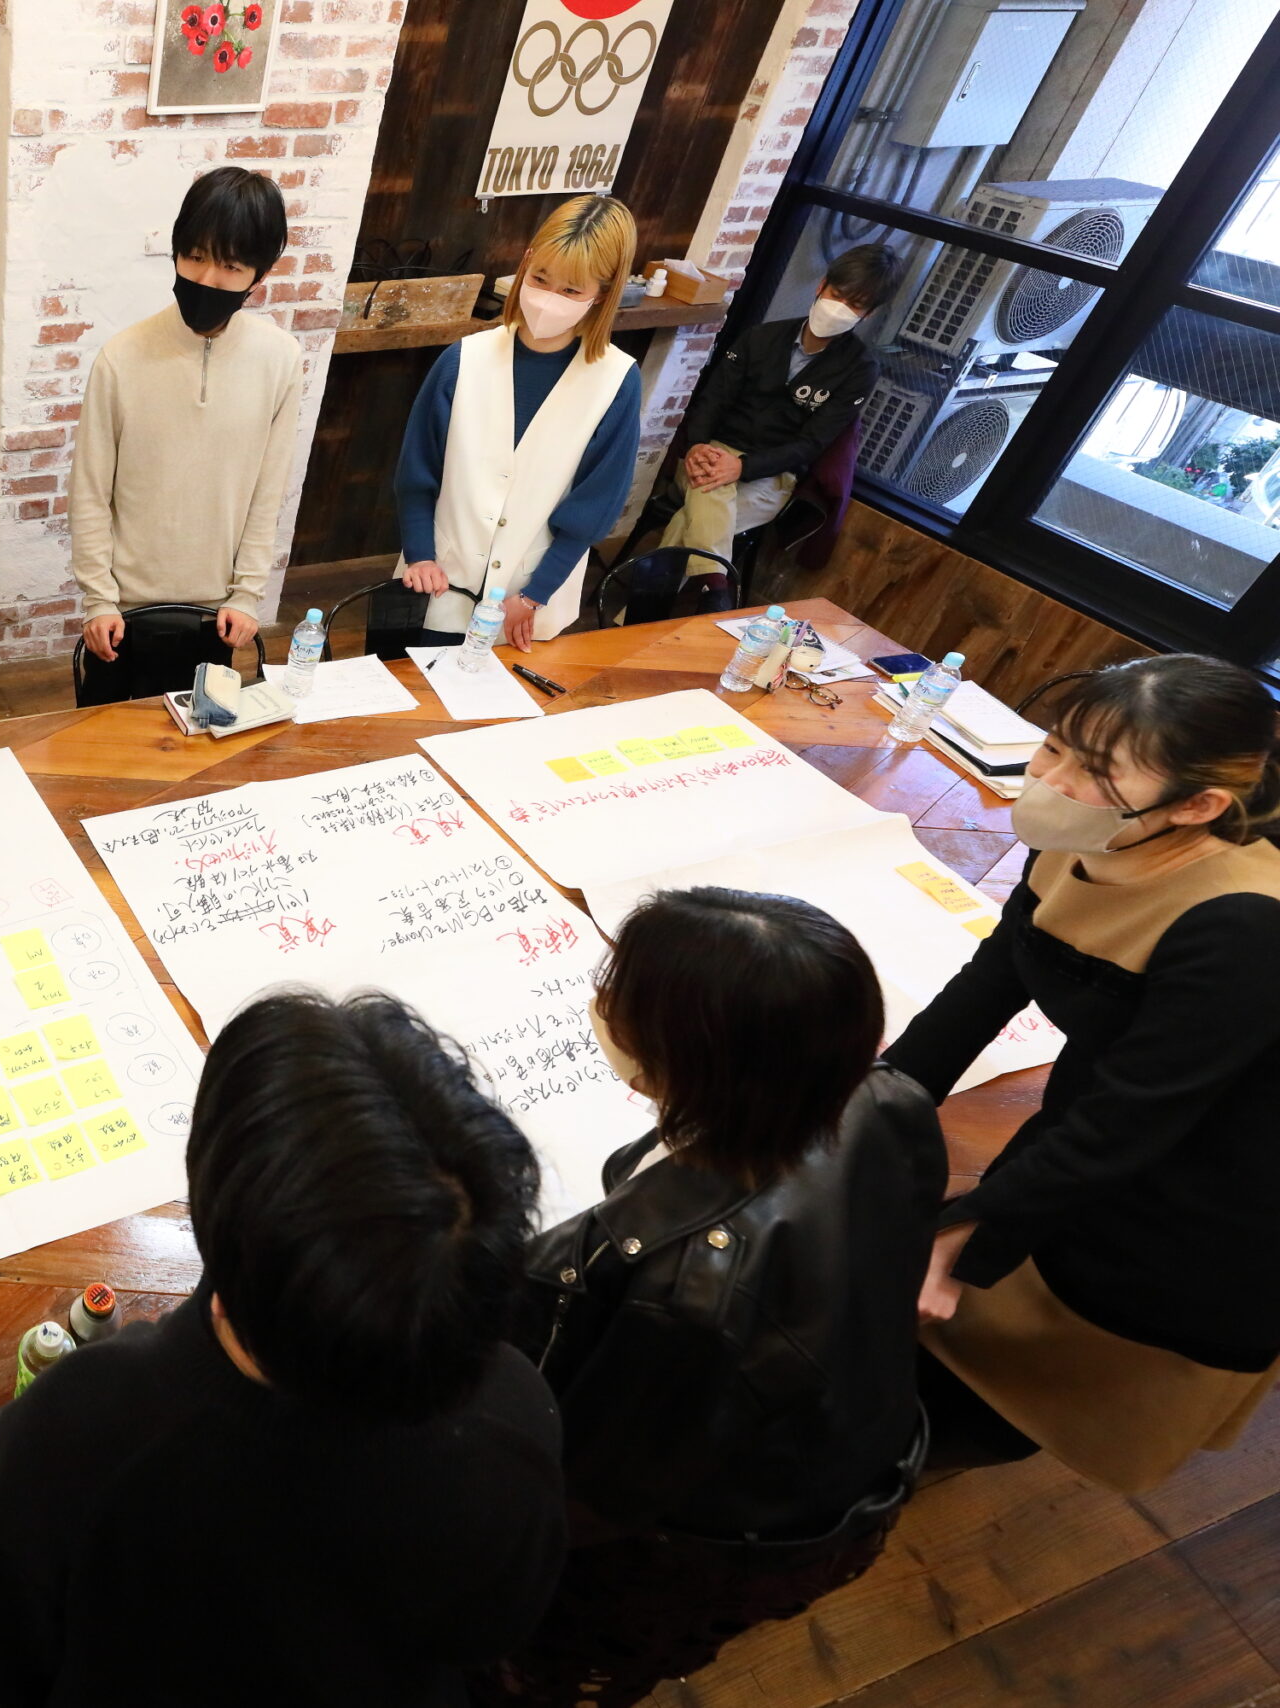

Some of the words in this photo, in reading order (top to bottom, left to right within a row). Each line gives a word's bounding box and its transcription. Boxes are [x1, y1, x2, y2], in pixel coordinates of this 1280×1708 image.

[482, 145, 560, 193] TOKYO
[563, 143, 621, 189] 1964
[393, 816, 467, 847] 視覚
